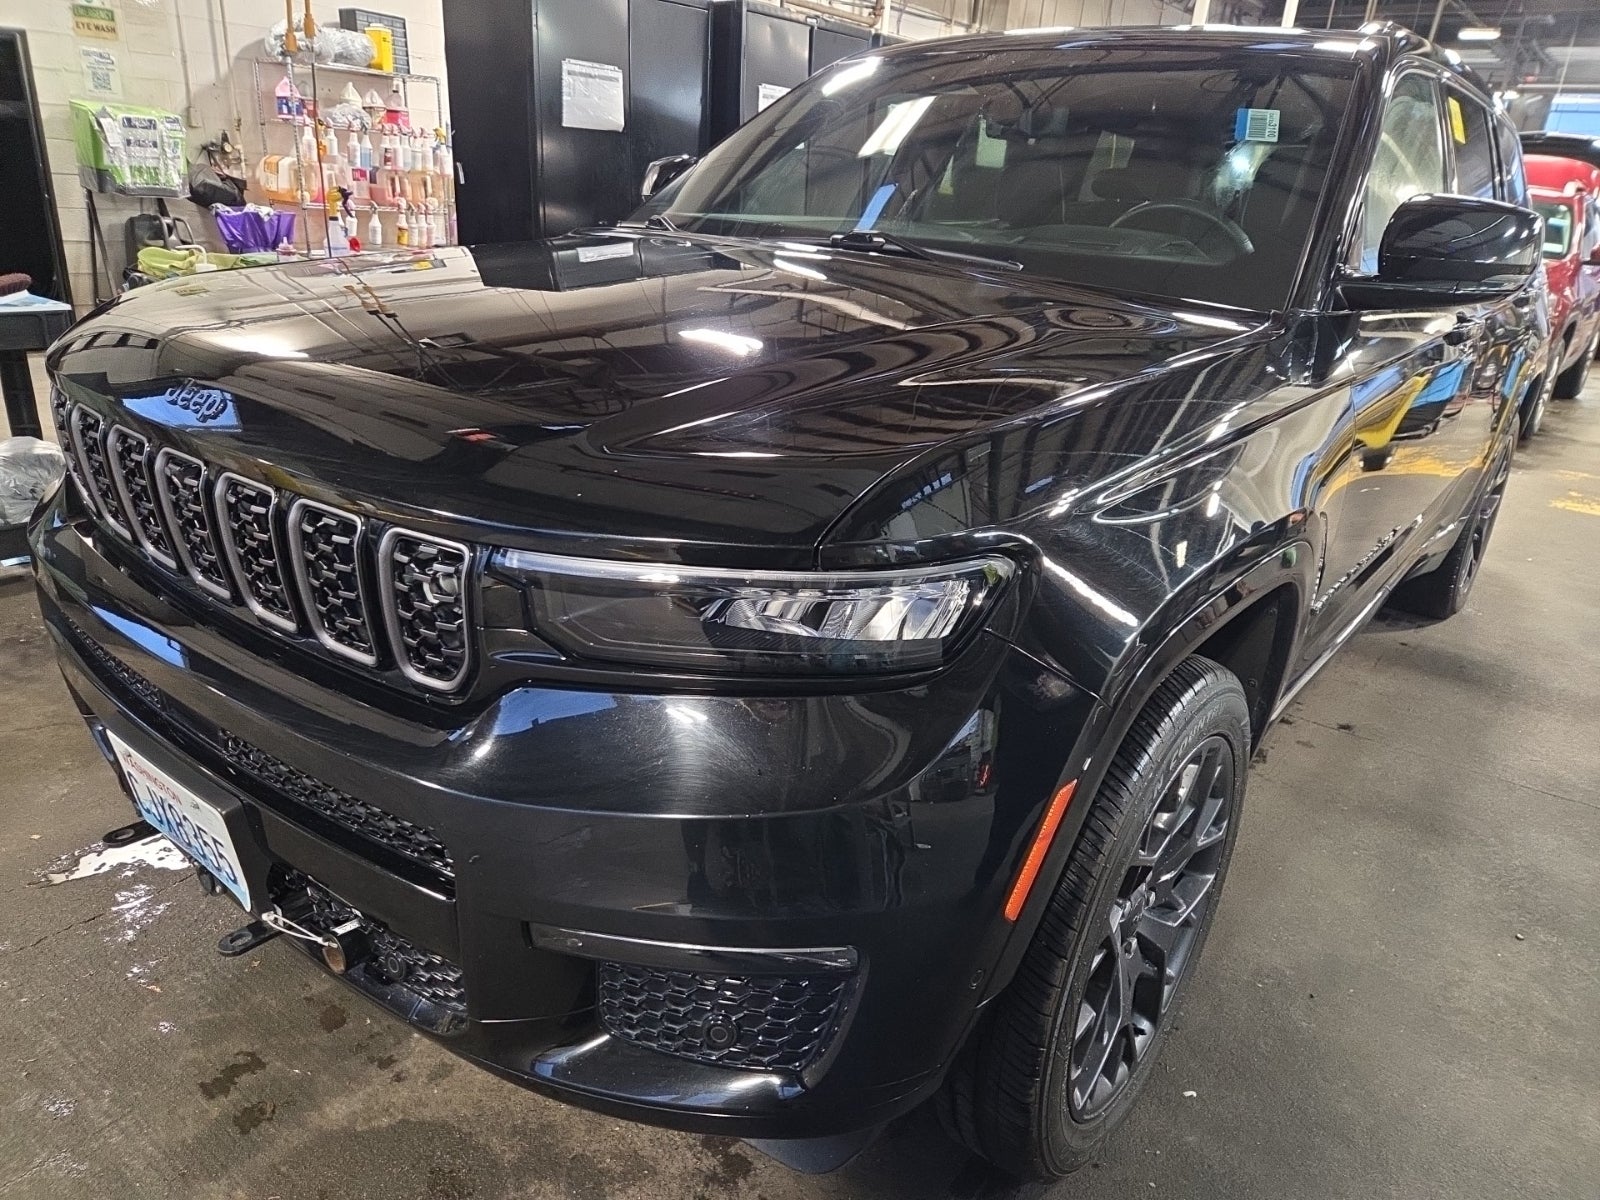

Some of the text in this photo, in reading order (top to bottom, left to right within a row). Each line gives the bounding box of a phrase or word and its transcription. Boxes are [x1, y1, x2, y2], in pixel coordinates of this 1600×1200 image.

[75, 21, 116, 34] EYE WASH
[164, 378, 227, 423] Jeep
[123, 756, 182, 806] WASHINGTON
[126, 770, 238, 885] CJX8355
